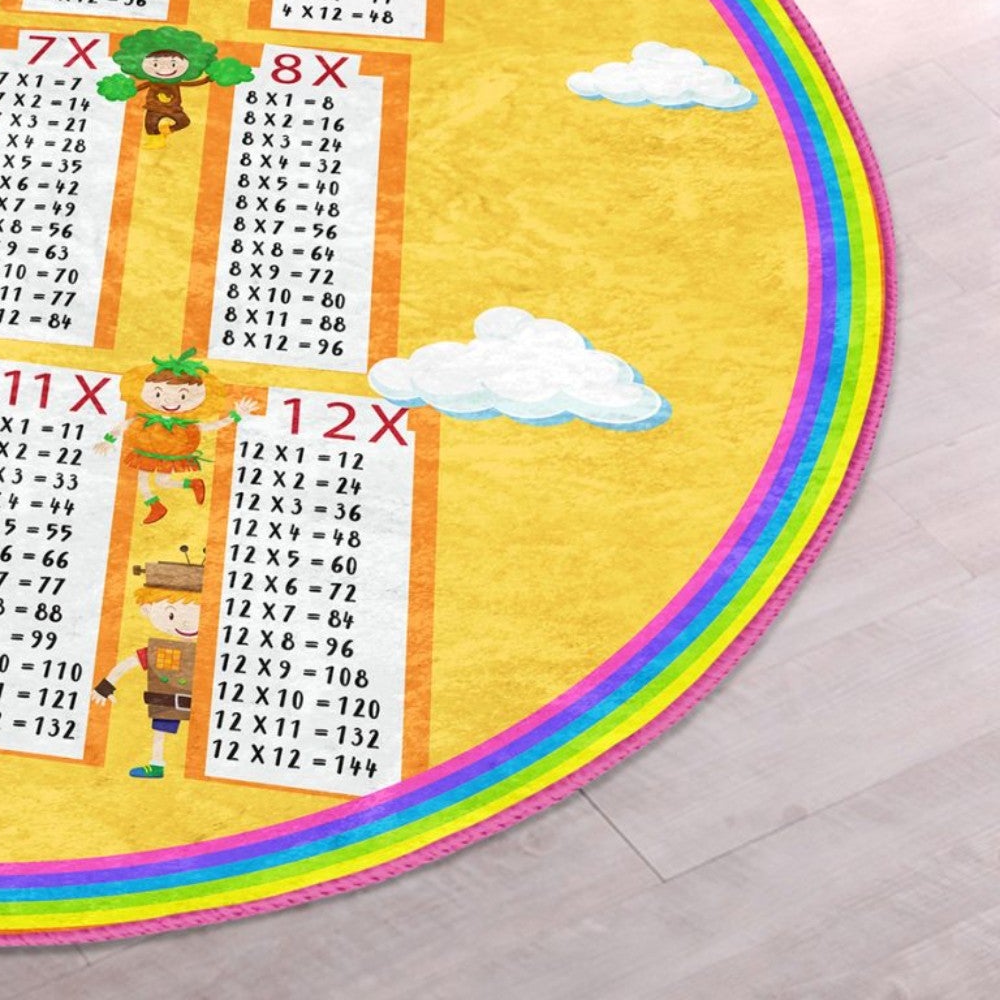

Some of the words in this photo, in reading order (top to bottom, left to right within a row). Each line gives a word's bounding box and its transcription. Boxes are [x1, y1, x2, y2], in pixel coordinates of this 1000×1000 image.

[244, 111, 256, 125] 8
[322, 117, 344, 132] 16
[61, 138, 86, 153] 28
[227, 283, 239, 299] 8
[321, 292, 345, 309] 80
[48, 313, 72, 330] 84
[56, 447, 82, 466] 22
[240, 441, 264, 460] 12
[339, 451, 363, 470] 12
[38, 576, 66, 595] 77
[221, 653, 246, 674] 12
[325, 666, 369, 688] 108
[35, 716, 76, 740] 132
[213, 739, 239, 761] 12
[335, 755, 377, 778] 144
